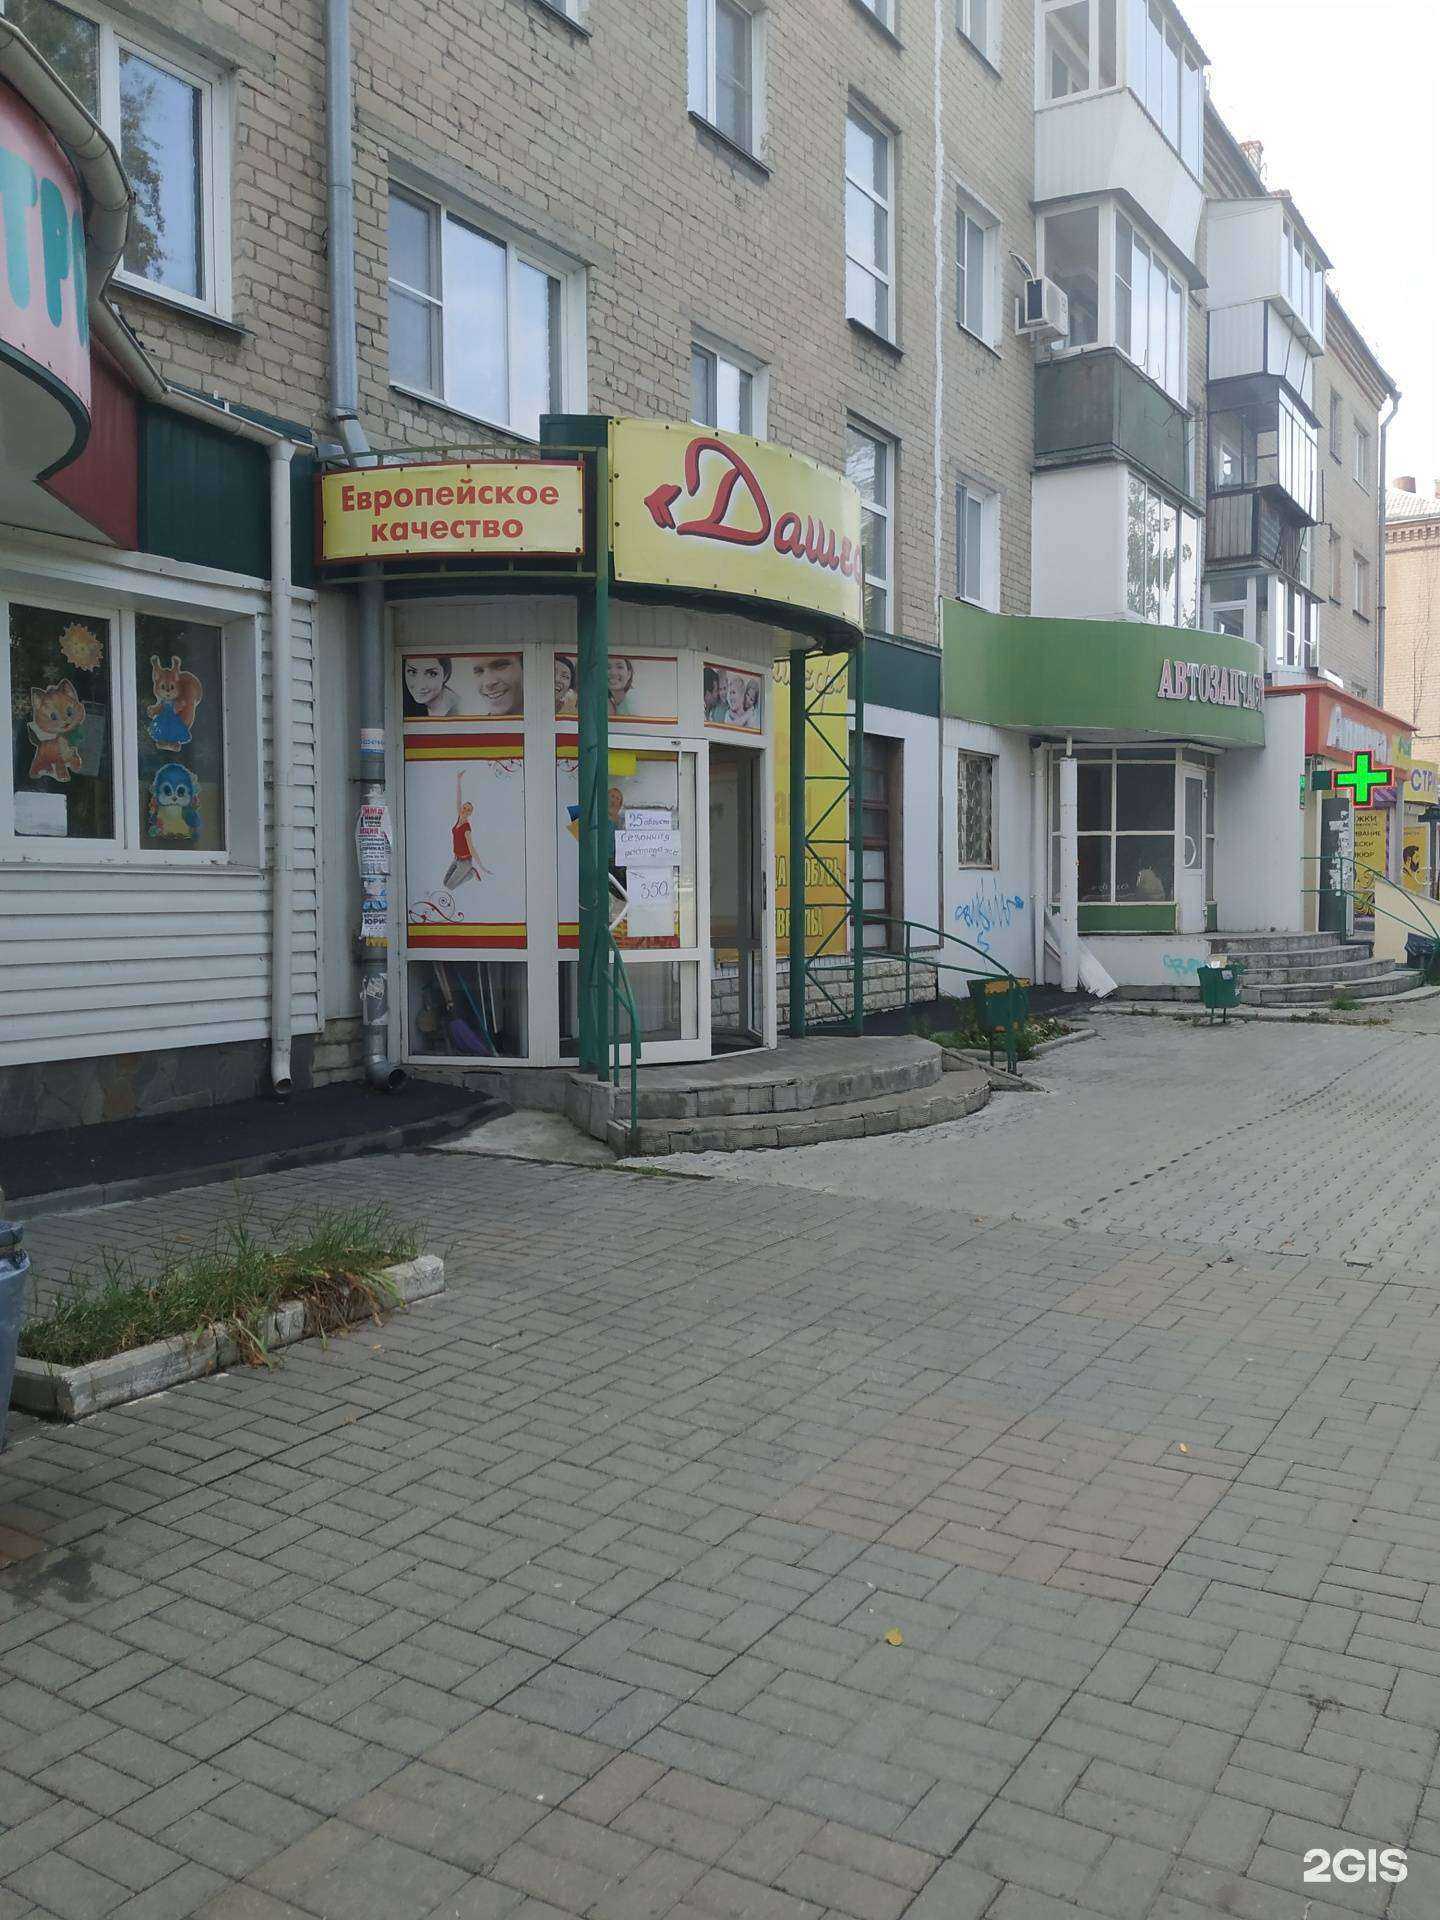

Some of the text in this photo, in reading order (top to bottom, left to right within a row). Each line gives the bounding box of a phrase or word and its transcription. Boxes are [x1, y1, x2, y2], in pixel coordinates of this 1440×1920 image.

[341, 478, 560, 517] Европейское
[371, 518, 524, 543] качество
[629, 812, 643, 827] 25
